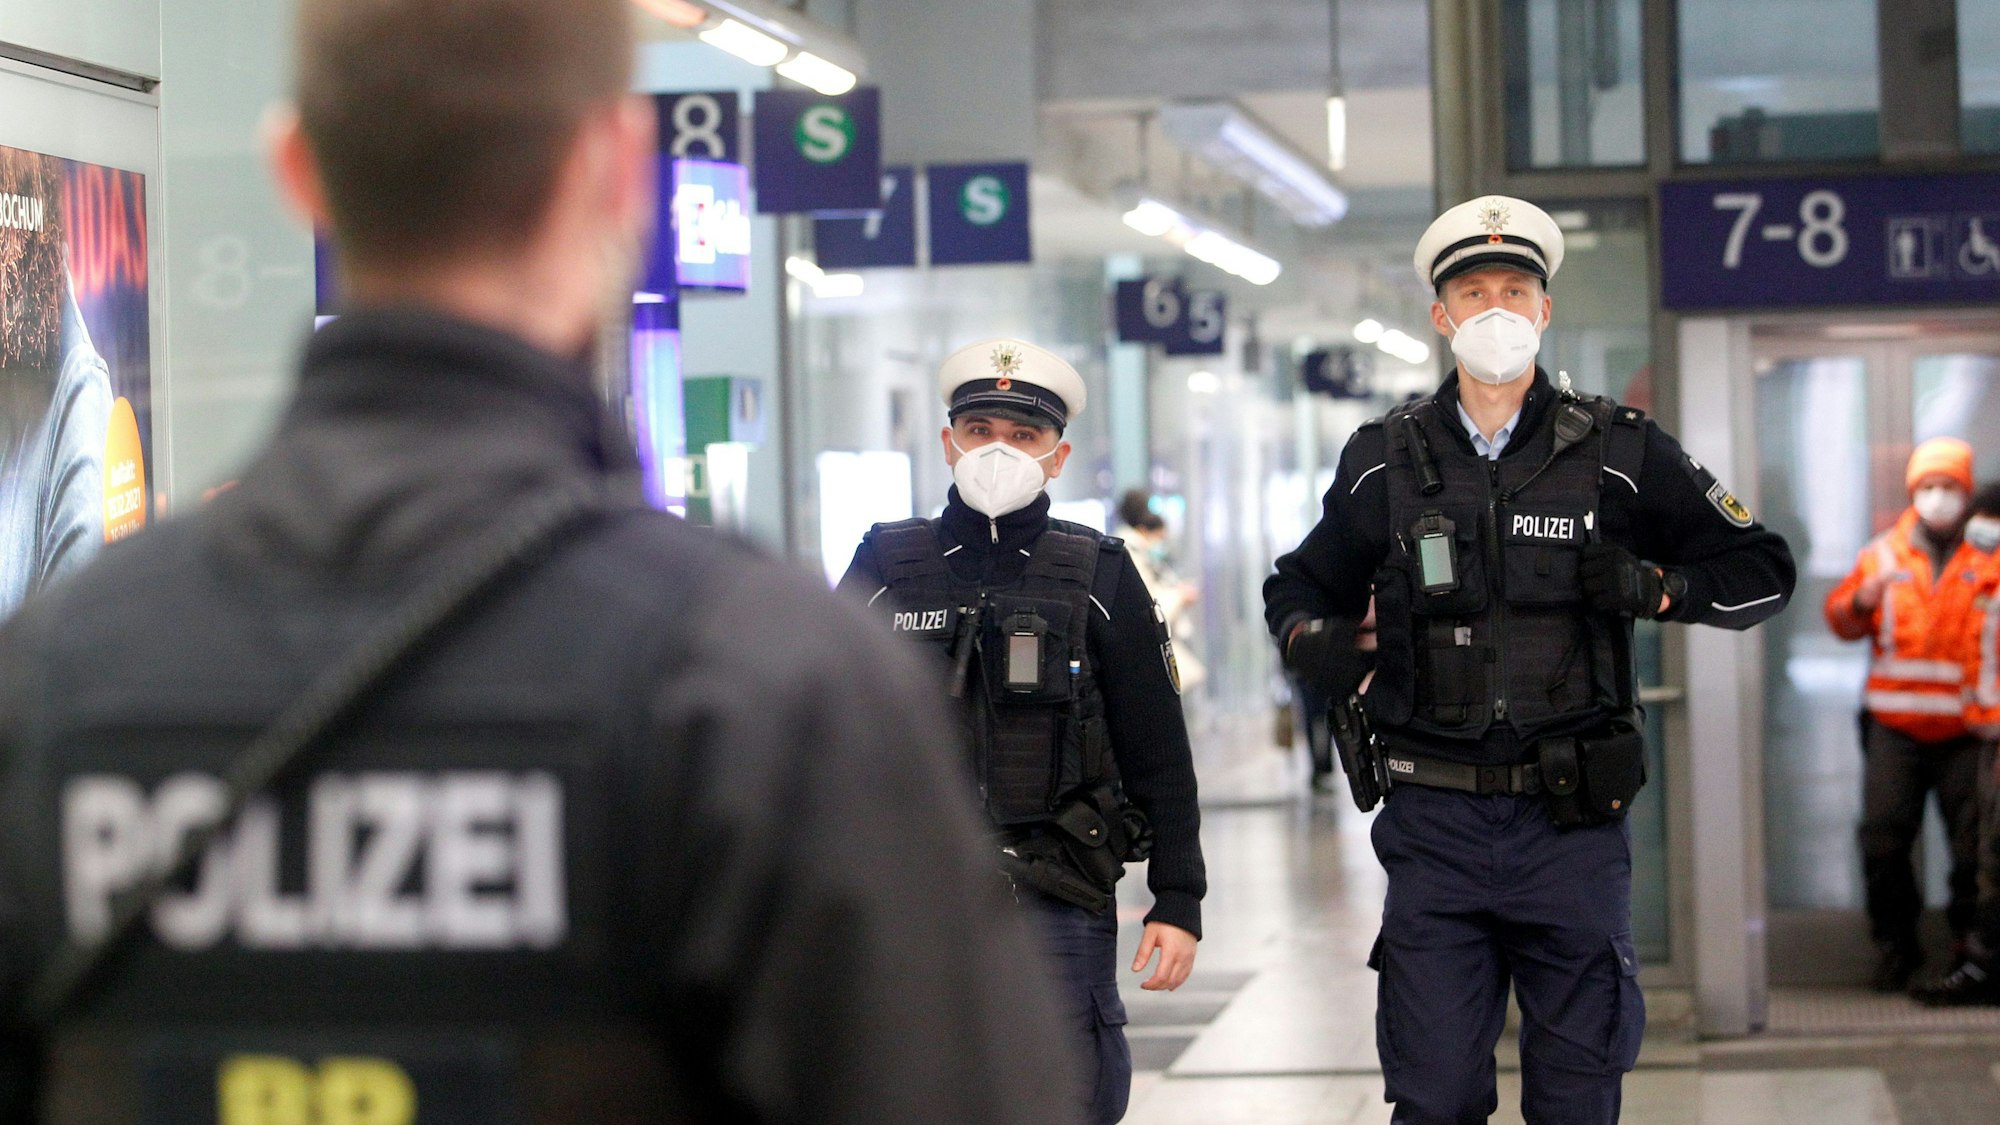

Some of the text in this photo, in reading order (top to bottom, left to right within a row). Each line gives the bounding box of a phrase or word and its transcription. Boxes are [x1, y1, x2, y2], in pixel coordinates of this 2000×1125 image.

[802, 107, 847, 160] S
[965, 177, 1005, 224] S
[1713, 190, 1849, 268] 7-8
[1143, 280, 1180, 328] 6
[1512, 514, 1575, 540] POLIZEI
[893, 609, 948, 631] POLIZEI
[63, 772, 567, 950] POLIZEI
